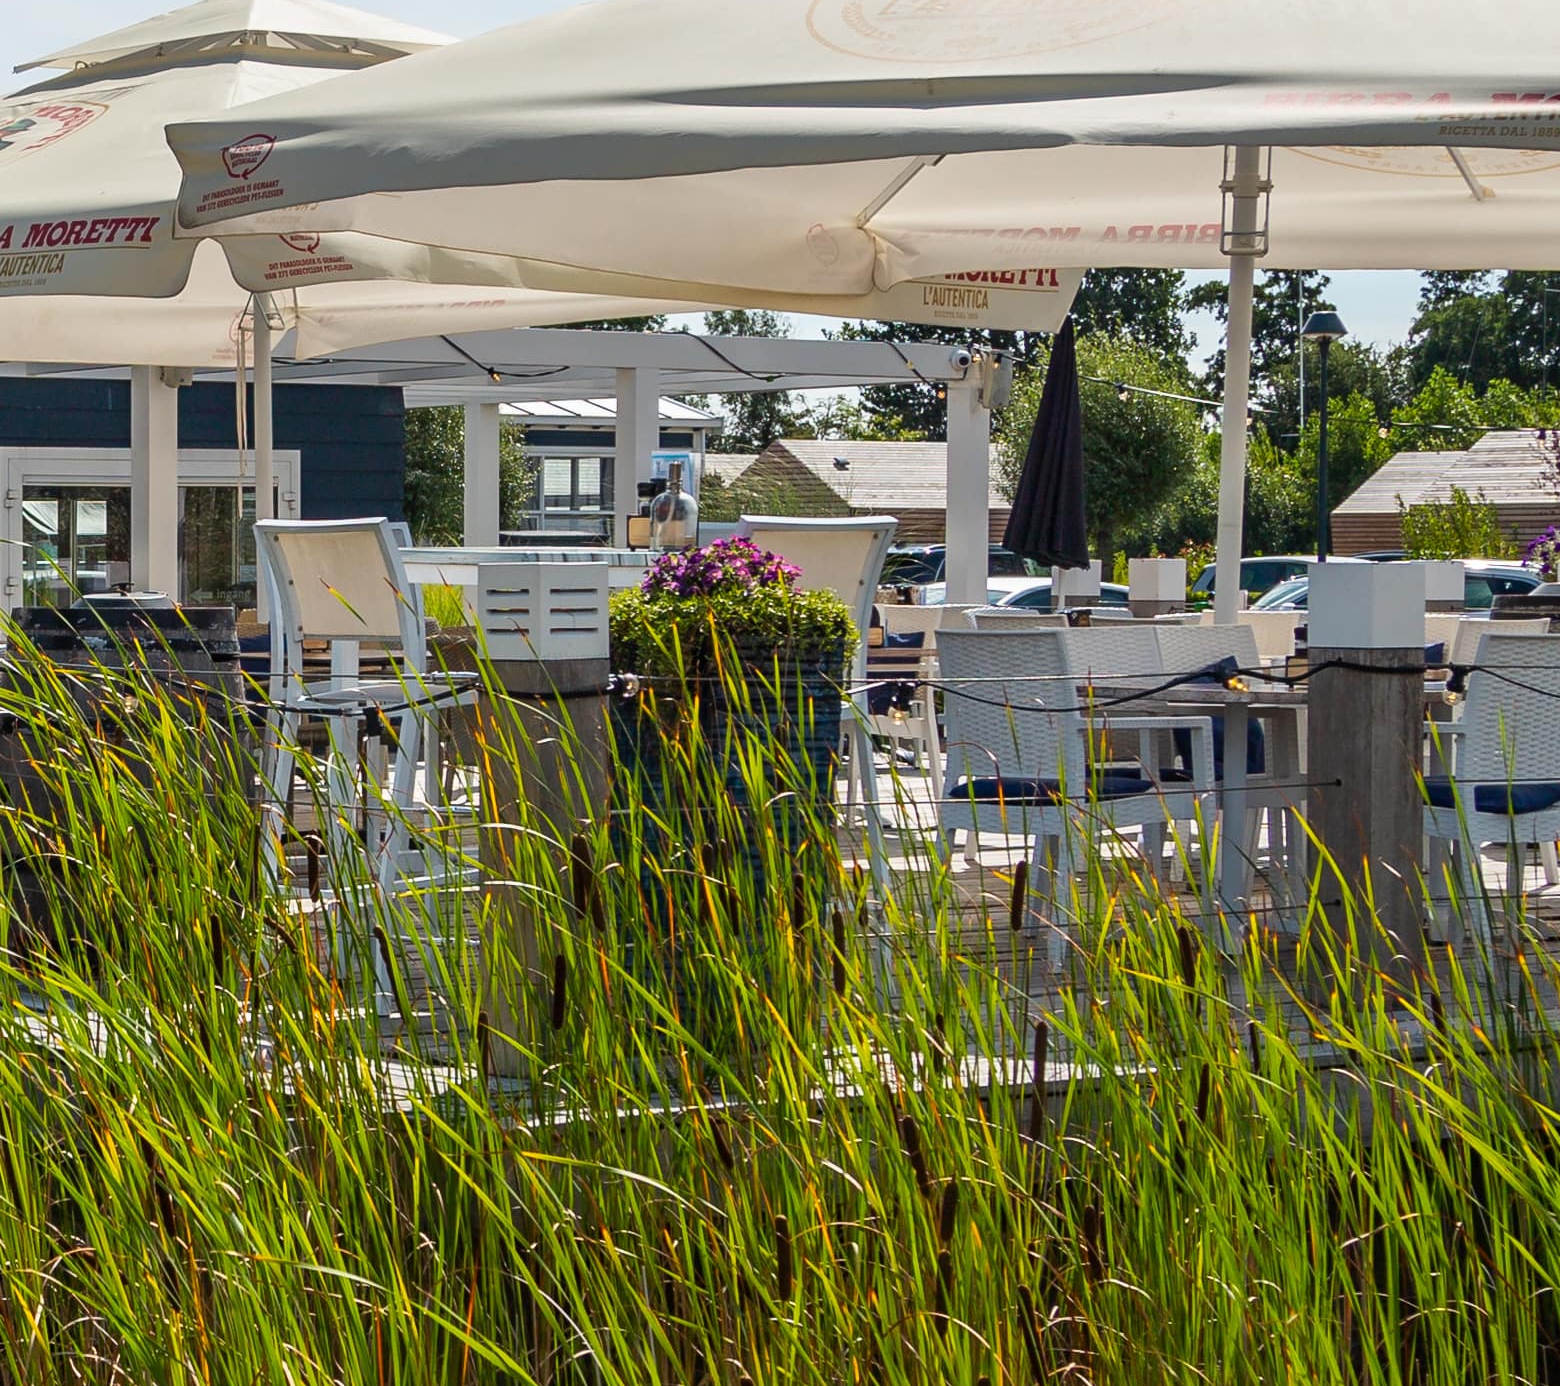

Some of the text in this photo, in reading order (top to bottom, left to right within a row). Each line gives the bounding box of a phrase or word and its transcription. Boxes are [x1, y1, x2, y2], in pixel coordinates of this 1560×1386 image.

[1439, 125, 1496, 137] RICETTA
[1500, 126, 1527, 138] DAL
[22, 216, 161, 249] MORETTI
[923, 286, 990, 310] L'AUTENTICA
